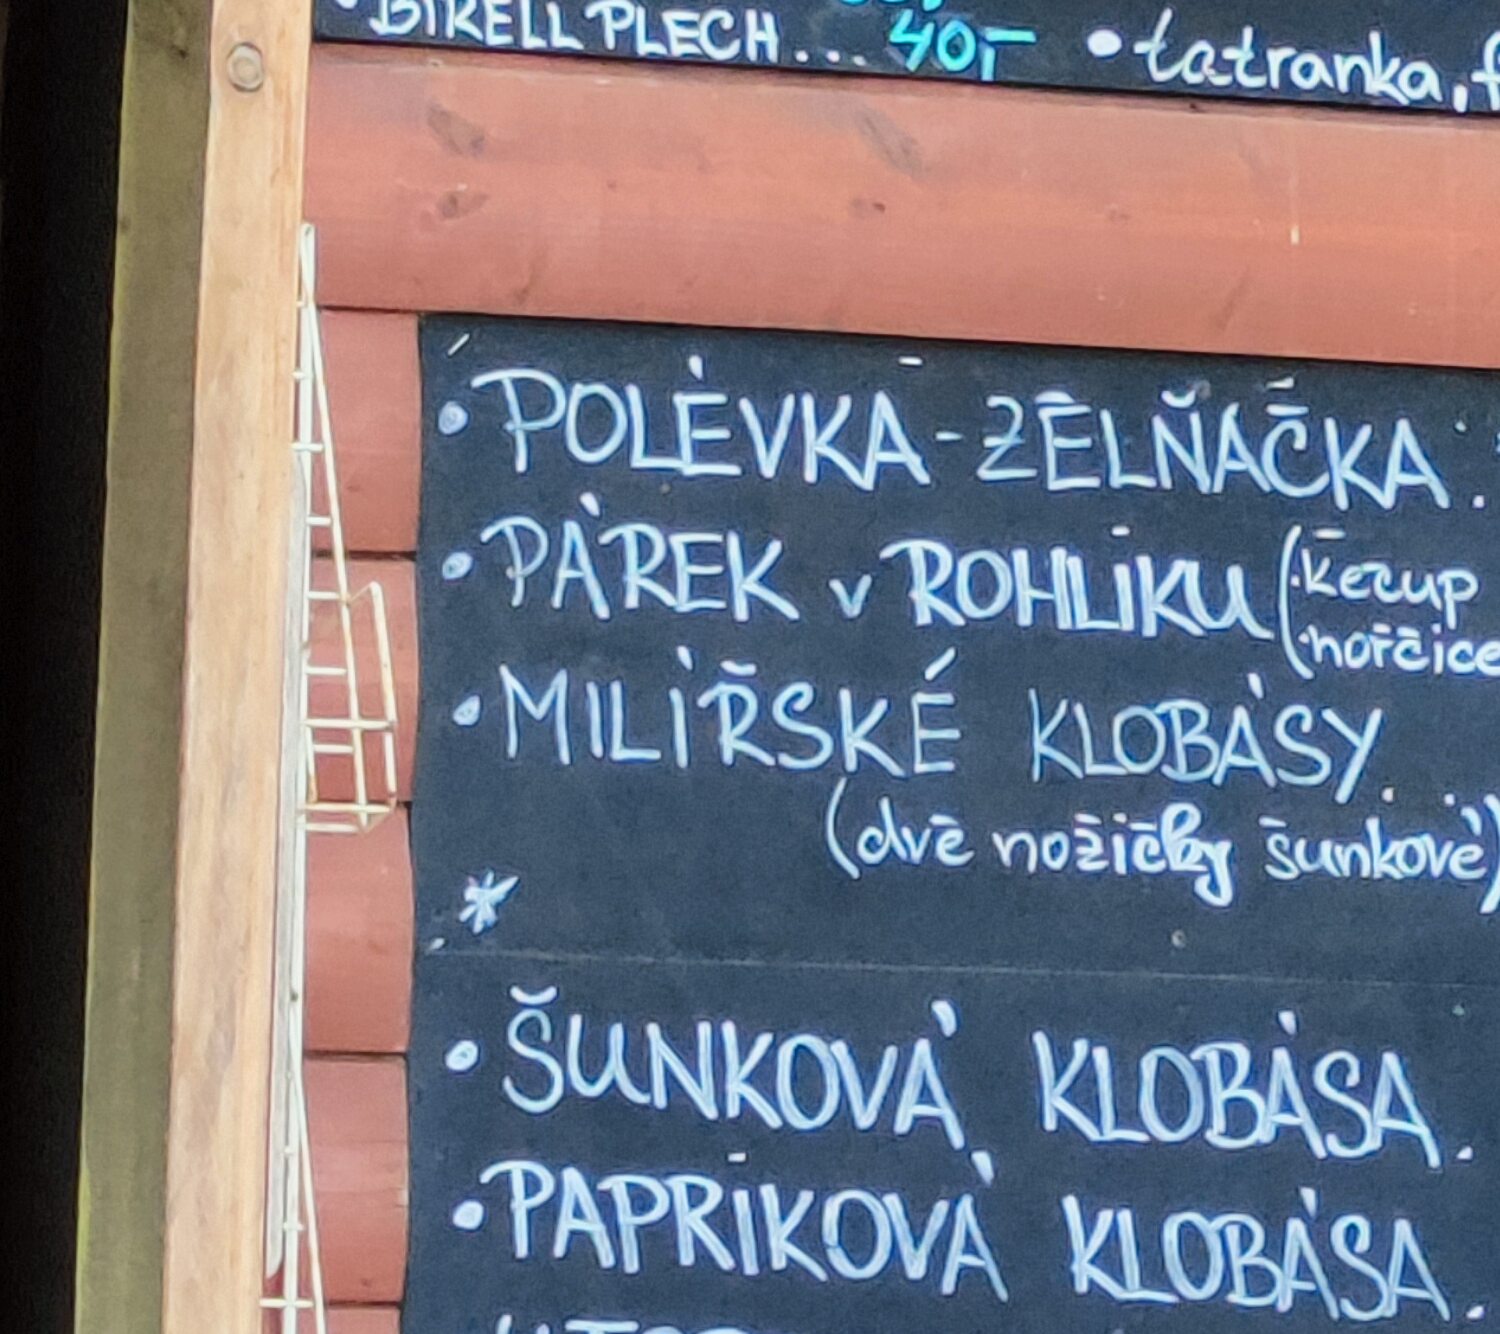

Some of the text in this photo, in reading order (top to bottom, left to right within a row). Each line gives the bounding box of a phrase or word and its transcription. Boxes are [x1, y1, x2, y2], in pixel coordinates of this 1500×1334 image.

[479, 491, 801, 622] PÁREK
[502, 985, 966, 1151] ŠUNKOVÁ
[1032, 1010, 1442, 1169] KLOBÁSA
[479, 1150, 1008, 1302] PAPRIKOVÁ
[1061, 1186, 1451, 1322] KLOBÁSA
